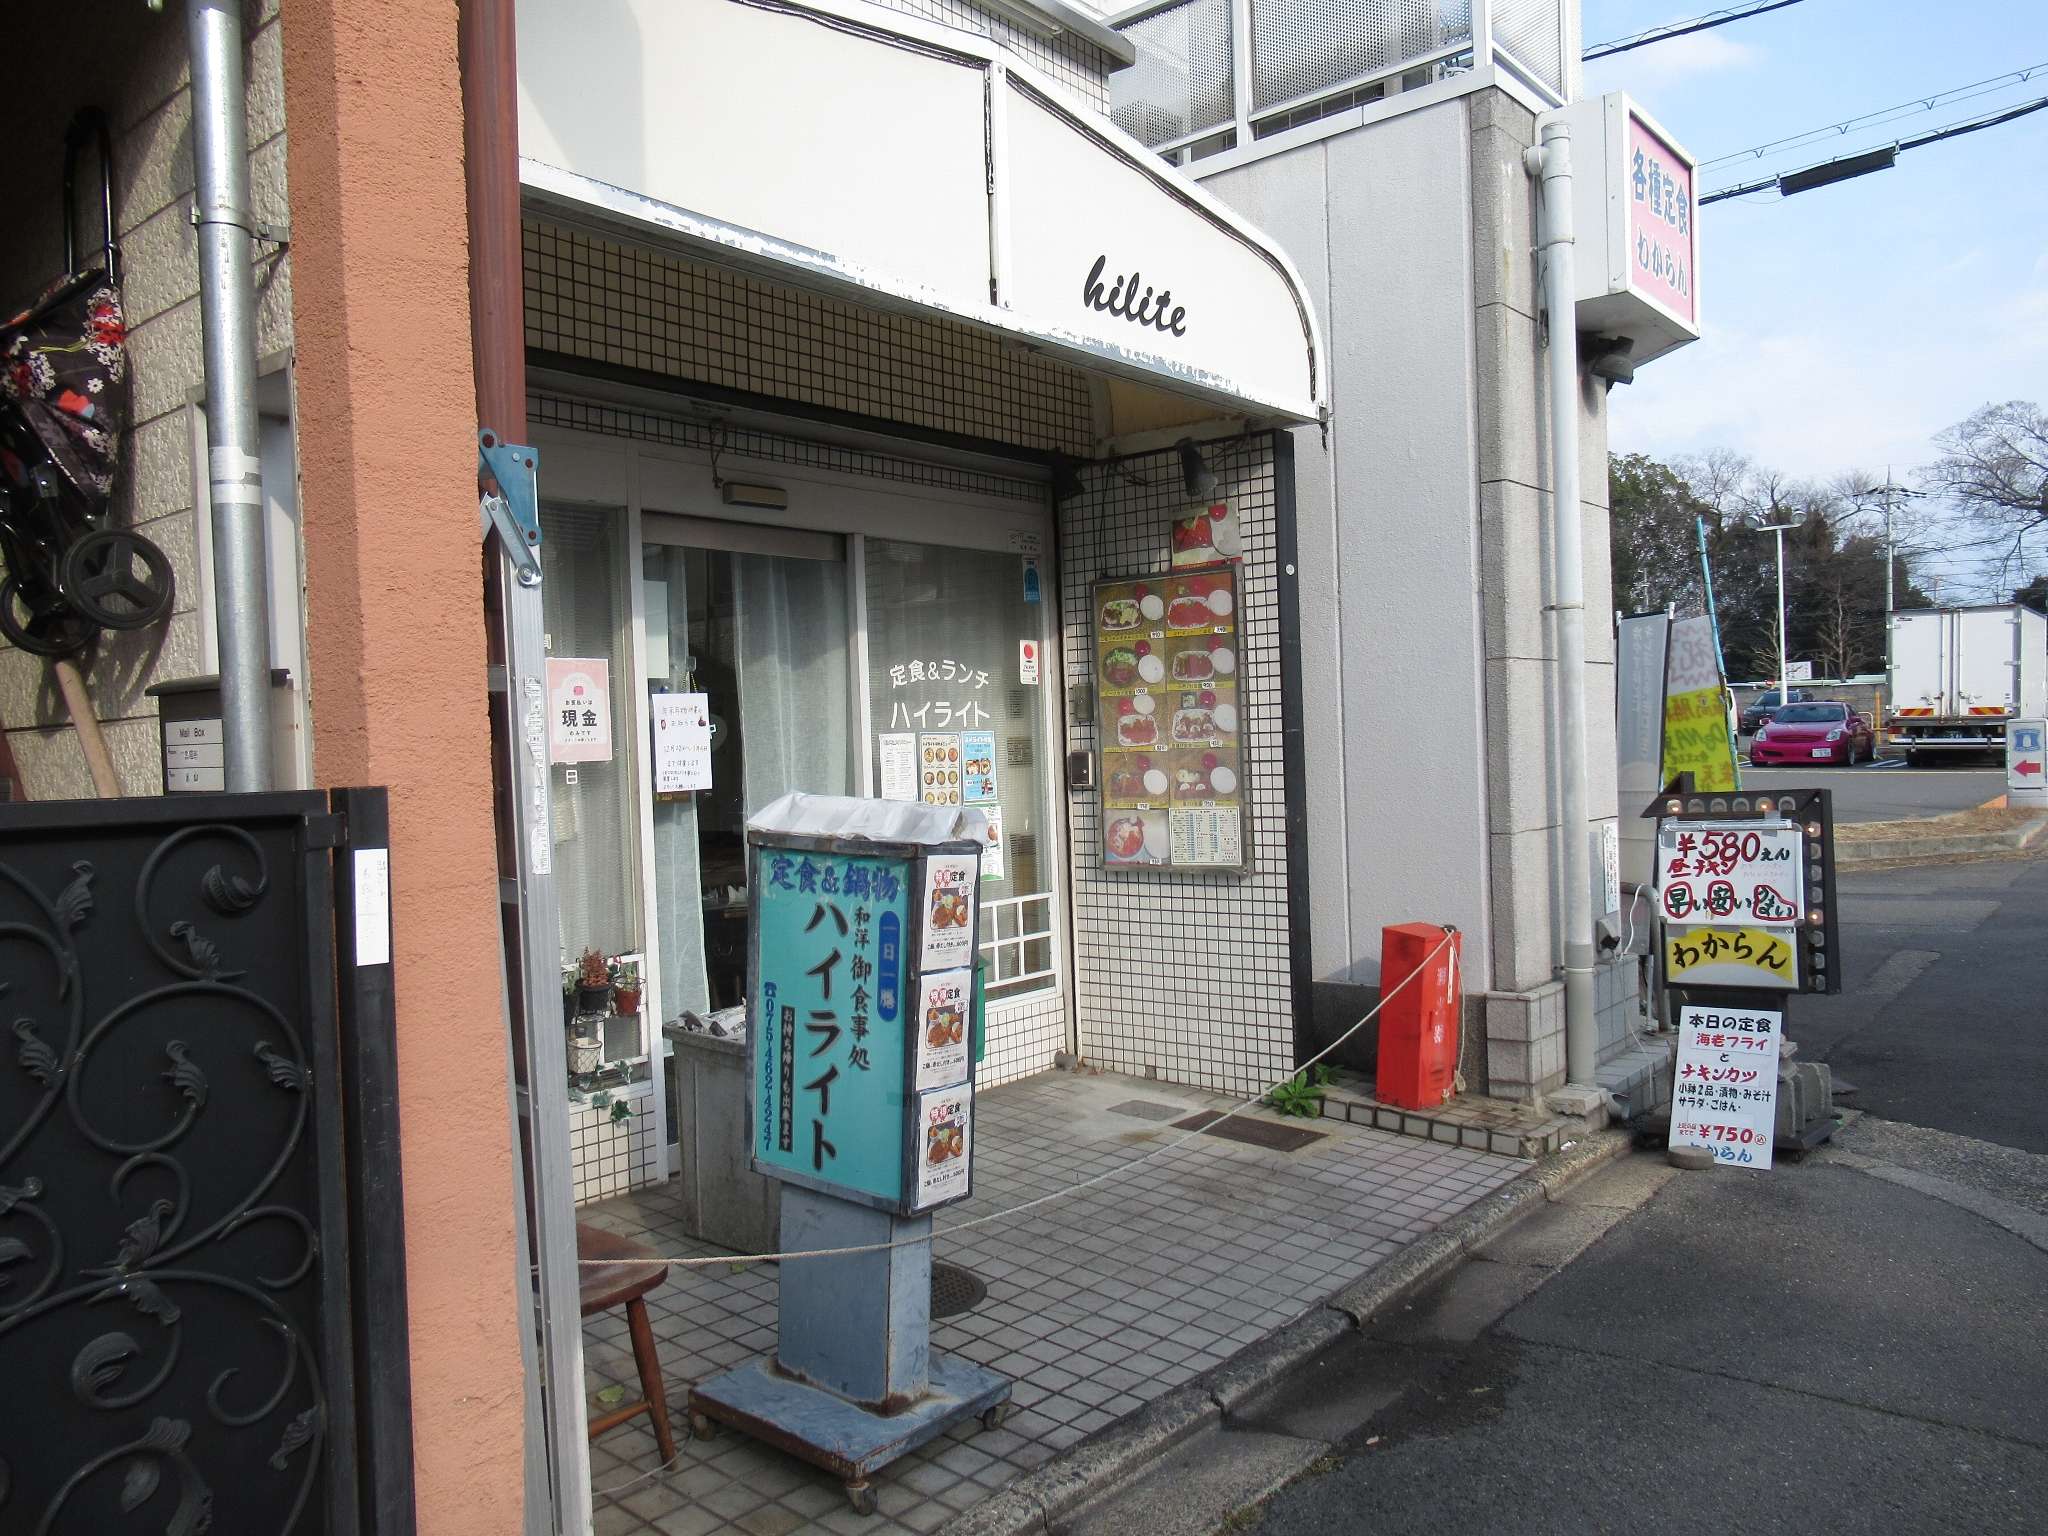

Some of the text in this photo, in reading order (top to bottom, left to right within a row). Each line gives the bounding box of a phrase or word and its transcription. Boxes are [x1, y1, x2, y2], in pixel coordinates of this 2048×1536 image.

[1632, 145, 1689, 238] 各種定食
[1637, 226, 1689, 297] わからん
[1084, 255, 1186, 338] hilite
[890, 659, 989, 689] 定食&ランチ
[562, 709, 598, 728] 現金
[890, 700, 990, 730] ハイライト
[769, 853, 900, 903] 定食&鍋物
[1673, 932, 1788, 970] わからん
[848, 905, 873, 1072] 和洋御食事処
[803, 900, 849, 1172] ハイライト
[1689, 1013, 1772, 1034] 本日の定食
[1695, 1032, 1769, 1051] 海老フライ
[1719, 1052, 1730, 1063] と
[1681, 1063, 1758, 1083] チキンカツ
